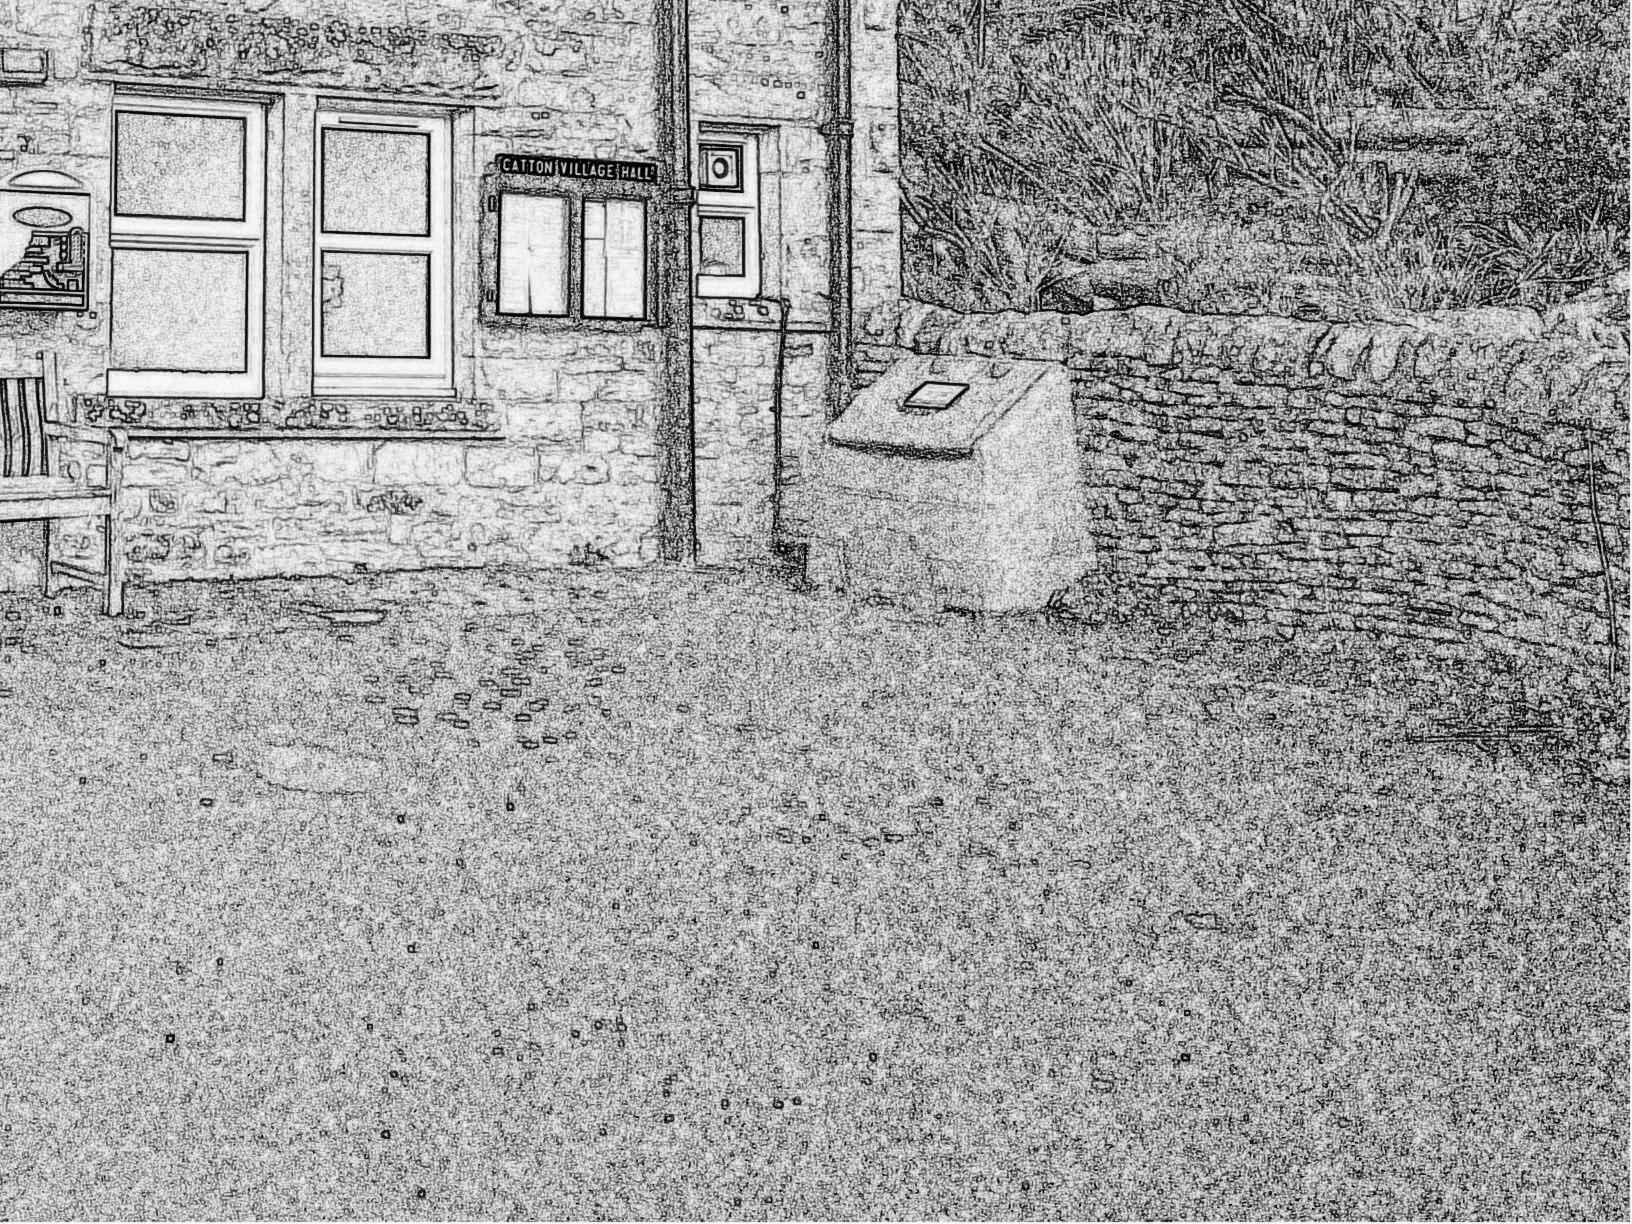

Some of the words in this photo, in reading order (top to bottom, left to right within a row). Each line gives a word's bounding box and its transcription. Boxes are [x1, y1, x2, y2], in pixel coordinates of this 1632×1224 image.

[502, 158, 553, 174] CATTON
[560, 161, 614, 178] VILLAGE
[621, 165, 652, 180] HALL
